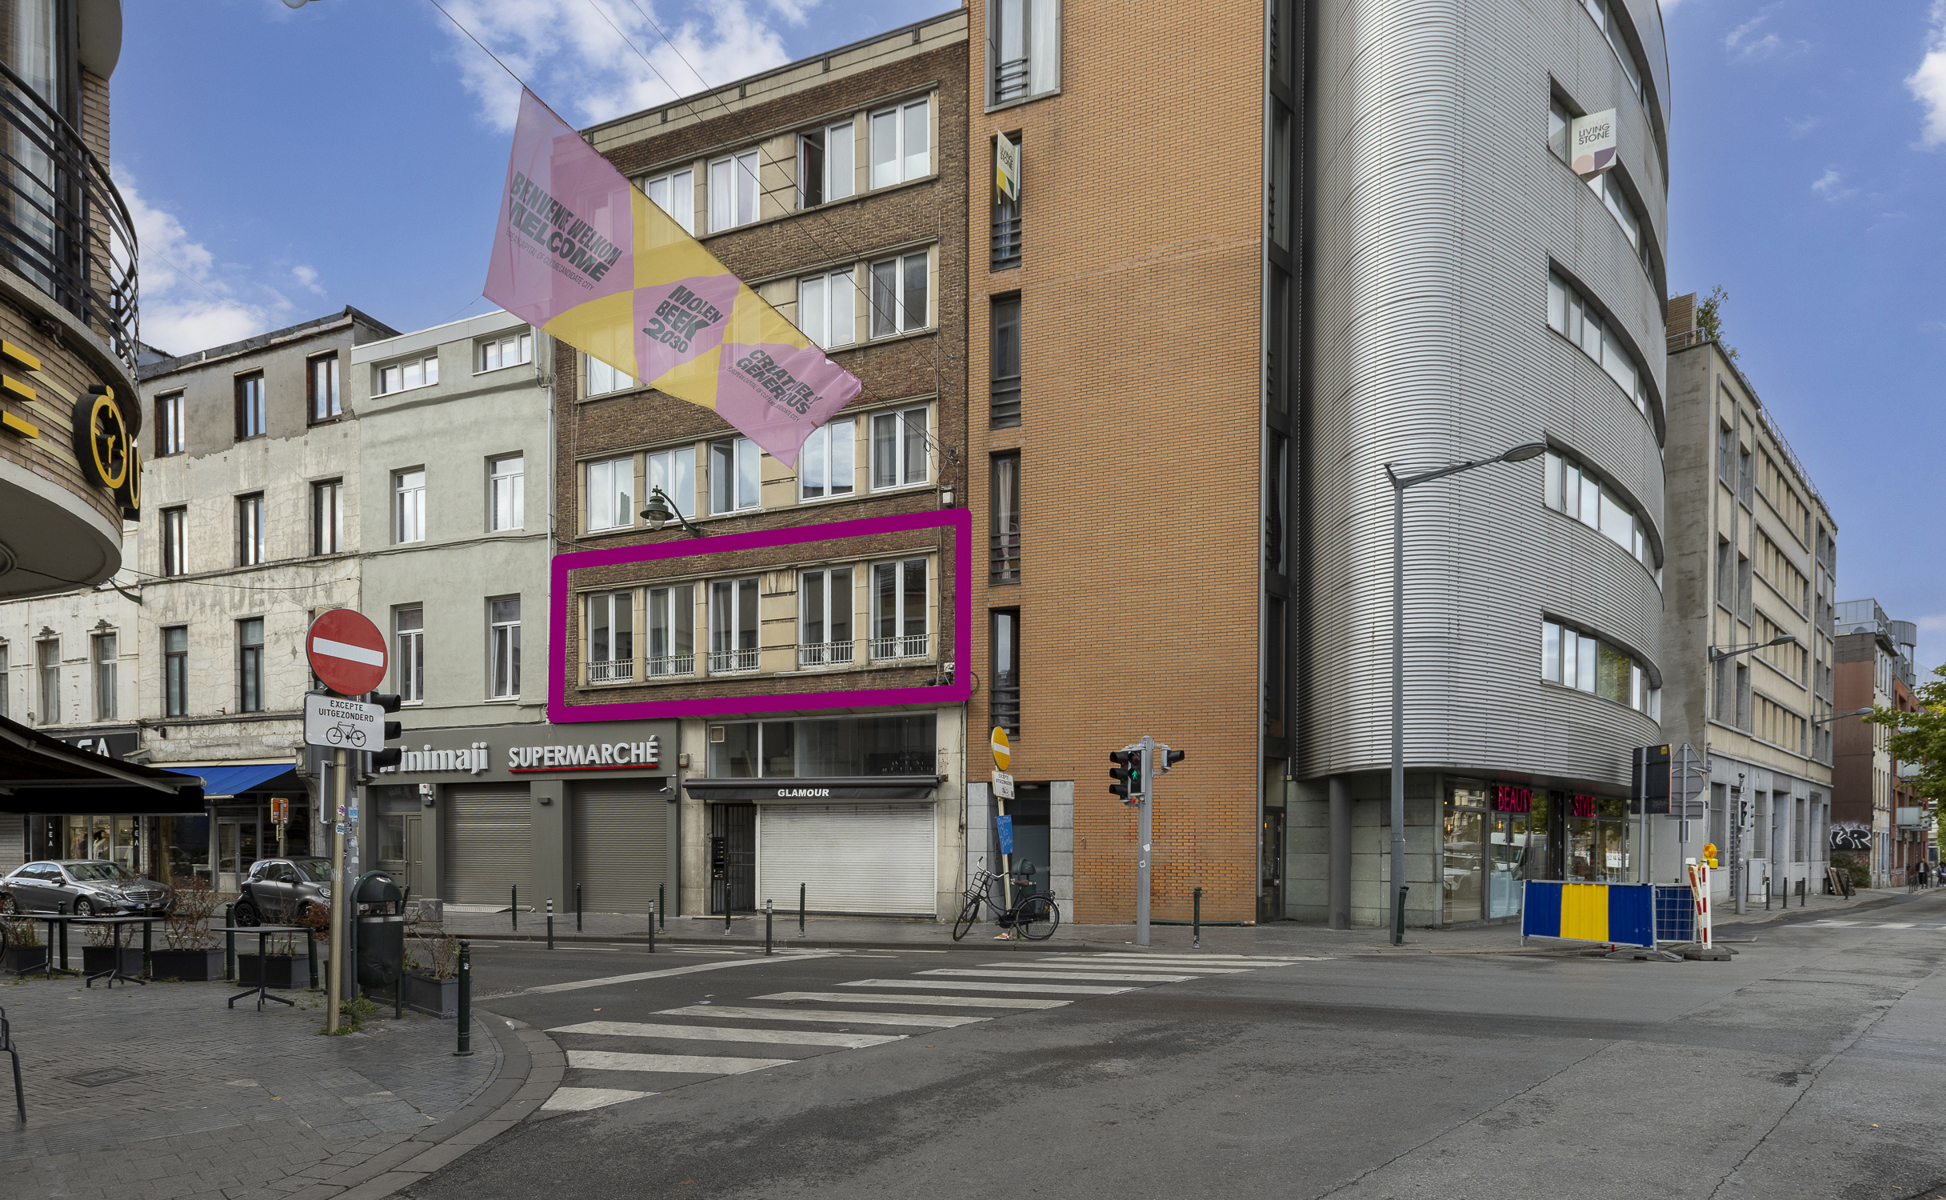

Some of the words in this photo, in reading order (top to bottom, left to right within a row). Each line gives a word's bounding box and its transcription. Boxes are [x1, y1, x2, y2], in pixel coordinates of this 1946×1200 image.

[1579, 123, 1610, 137] LIVING
[1579, 130, 1610, 145] STONE
[566, 217, 623, 267] WELKOM
[582, 280, 595, 292] CITY
[668, 285, 724, 324] MOLEN
[655, 300, 711, 343] BEEK
[642, 317, 689, 354] 2030
[736, 357, 811, 415] GENEROUS
[318, 708, 374, 723] UITGEZONDERD
[330, 700, 364, 712] EXCEPTE
[380, 742, 488, 775] inimaji
[508, 734, 659, 768] SUPERMARCHÉ
[777, 788, 830, 797] GLAMOUR
[1498, 786, 1533, 813] BEAUTY
[1574, 795, 1596, 818] STYLE
